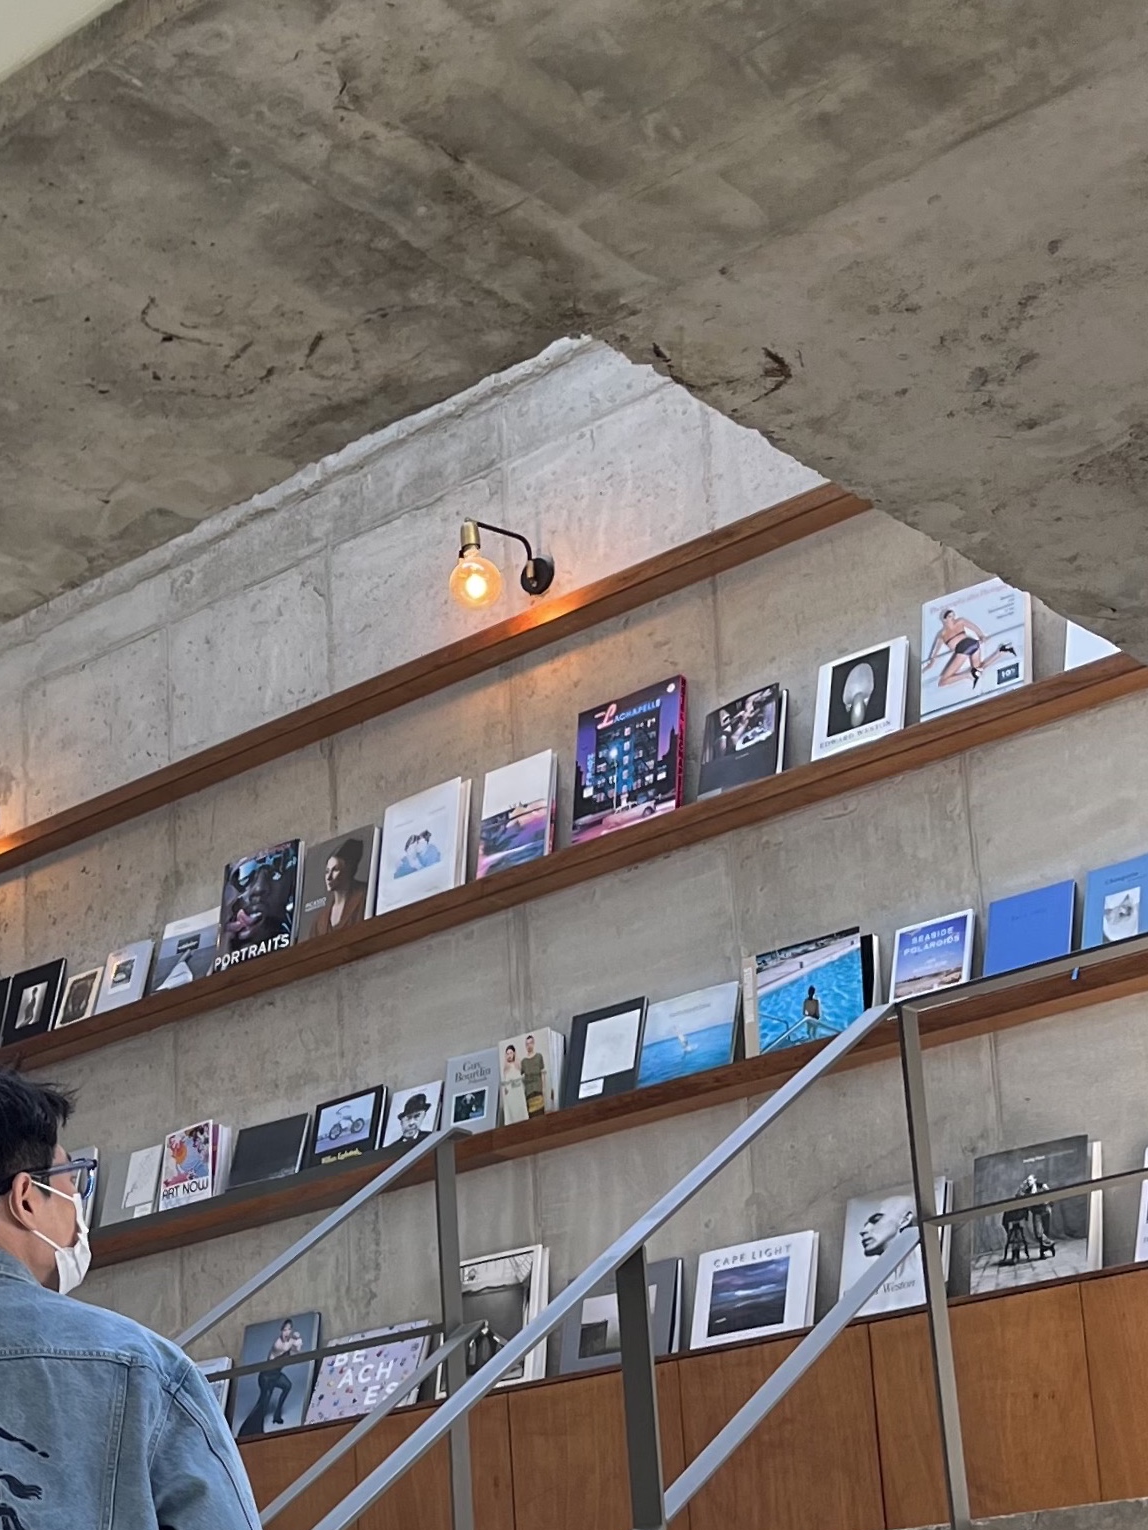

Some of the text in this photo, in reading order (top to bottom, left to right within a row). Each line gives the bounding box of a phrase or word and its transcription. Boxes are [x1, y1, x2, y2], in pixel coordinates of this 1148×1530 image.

[903, 934, 960, 956] POLAROIDS
[911, 926, 954, 945] SEASIDE
[214, 933, 290, 972] PORTRAITS
[162, 1178, 209, 1200] ART NOW
[713, 1244, 791, 1268] CAPE LIGHT
[337, 1359, 394, 1389] ACH
